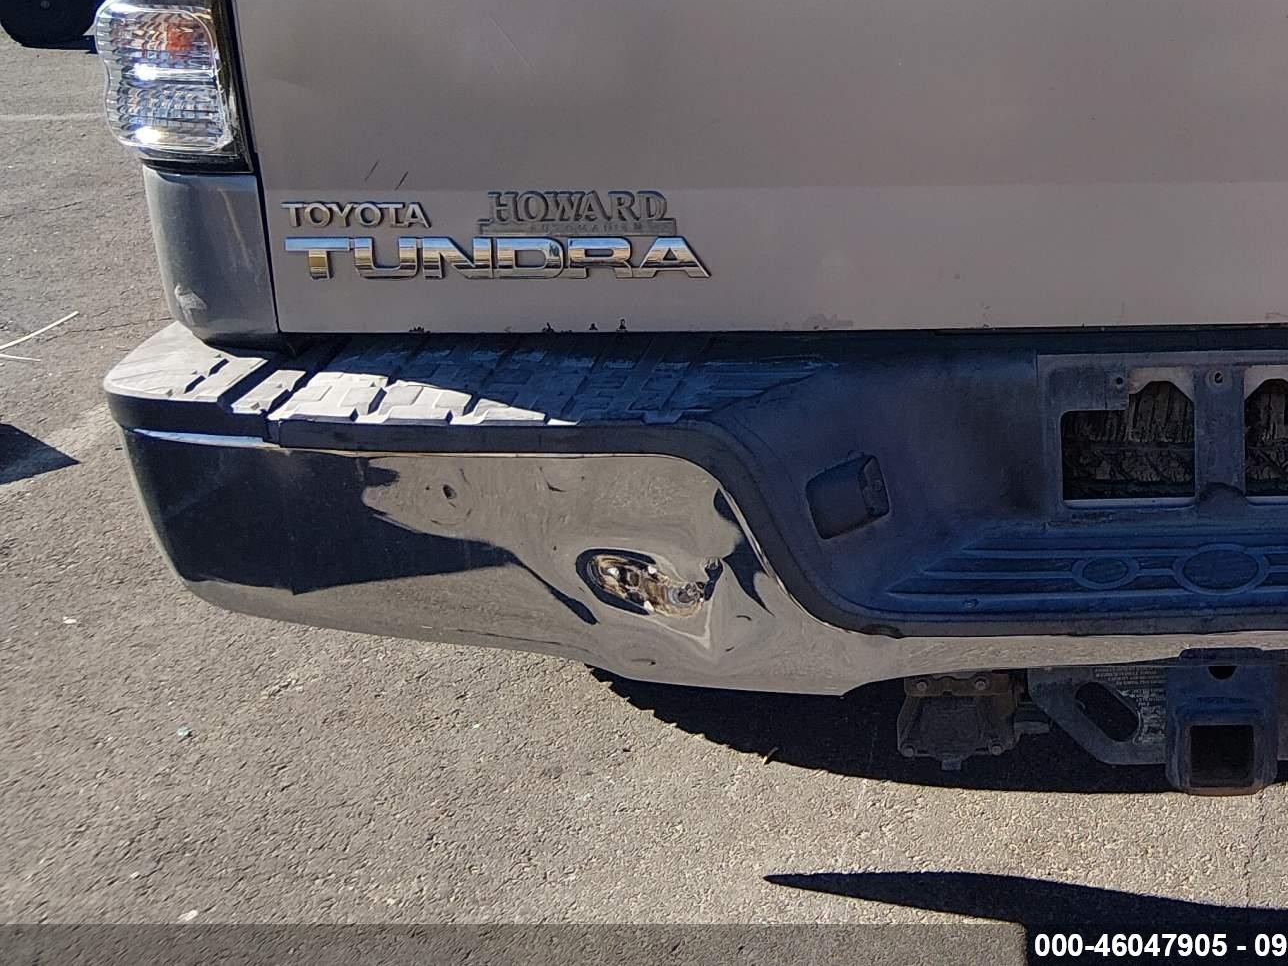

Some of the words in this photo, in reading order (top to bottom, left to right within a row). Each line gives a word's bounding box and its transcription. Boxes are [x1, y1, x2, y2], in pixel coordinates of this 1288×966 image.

[281, 201, 432, 229] TOYOTA
[487, 191, 668, 223] HOWARD
[284, 236, 712, 281] TUNDRA
